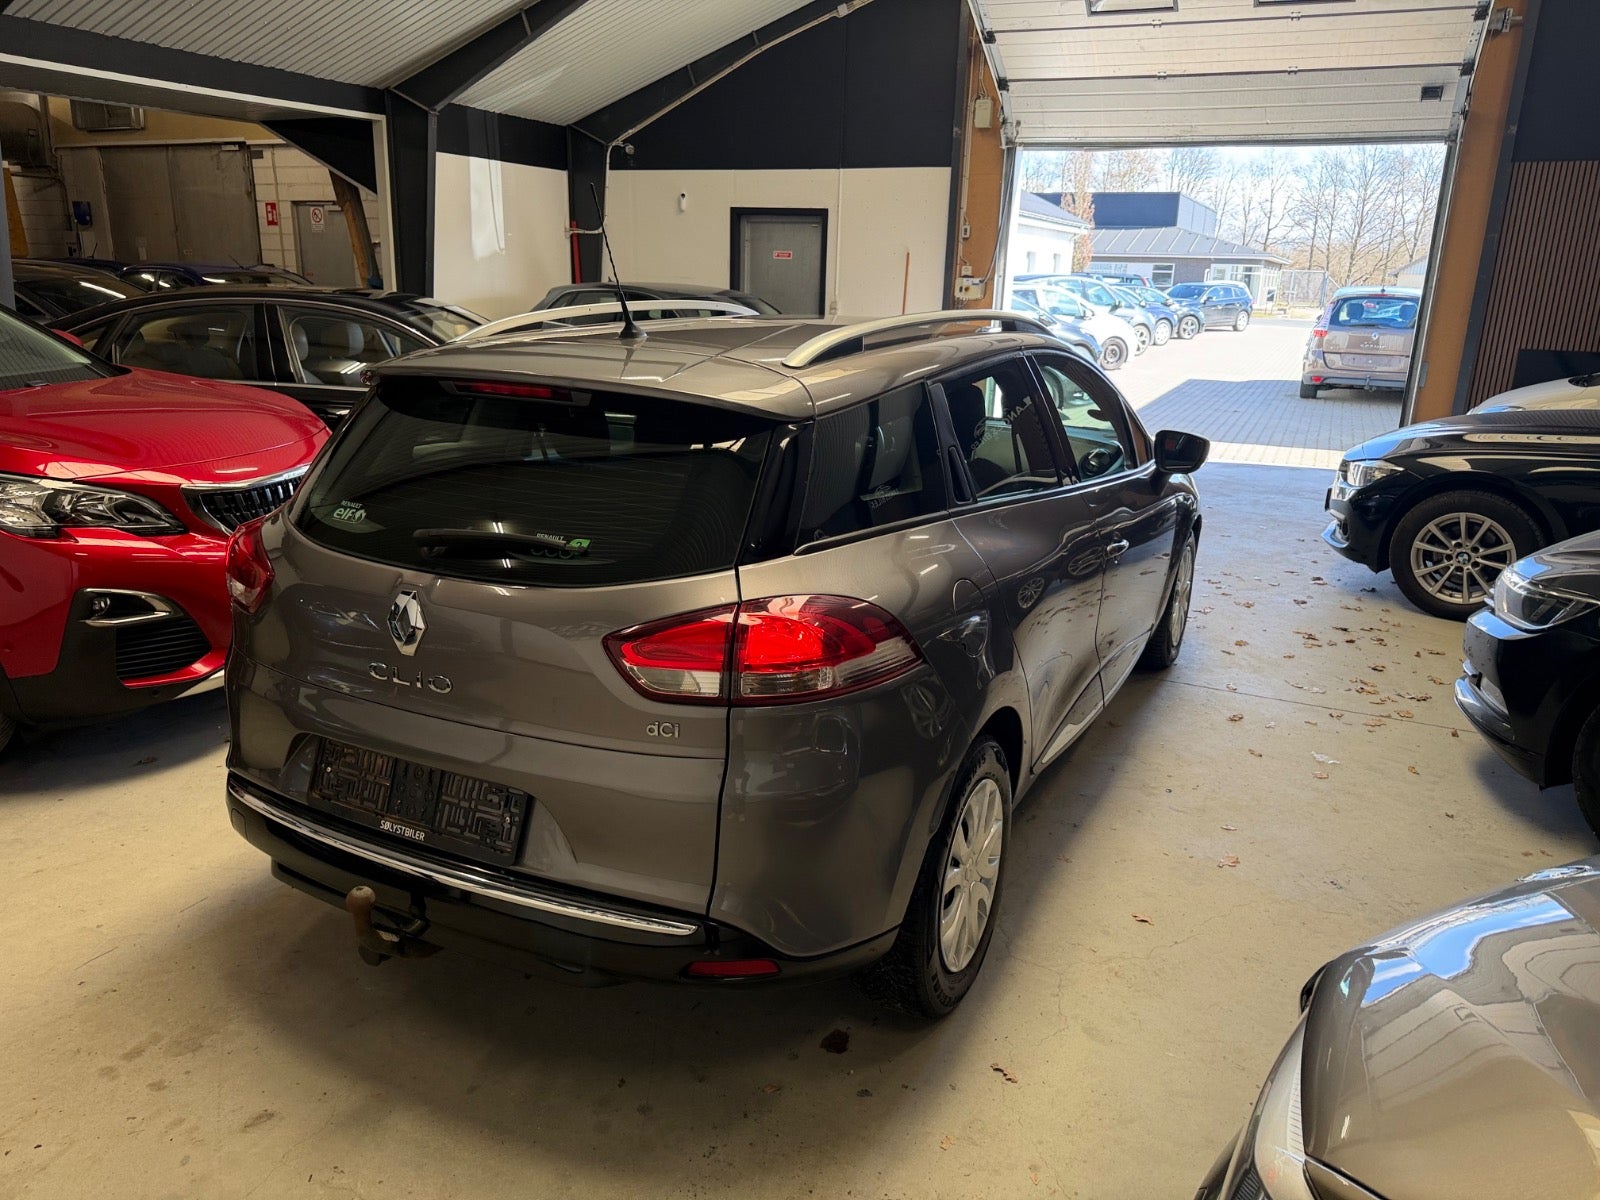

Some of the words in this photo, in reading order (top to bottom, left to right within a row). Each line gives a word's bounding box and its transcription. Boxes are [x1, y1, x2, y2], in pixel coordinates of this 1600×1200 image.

[368, 662, 453, 694] CLIO
[646, 721, 681, 739] dCi
[380, 820, 425, 841] SØLYSTBILER
